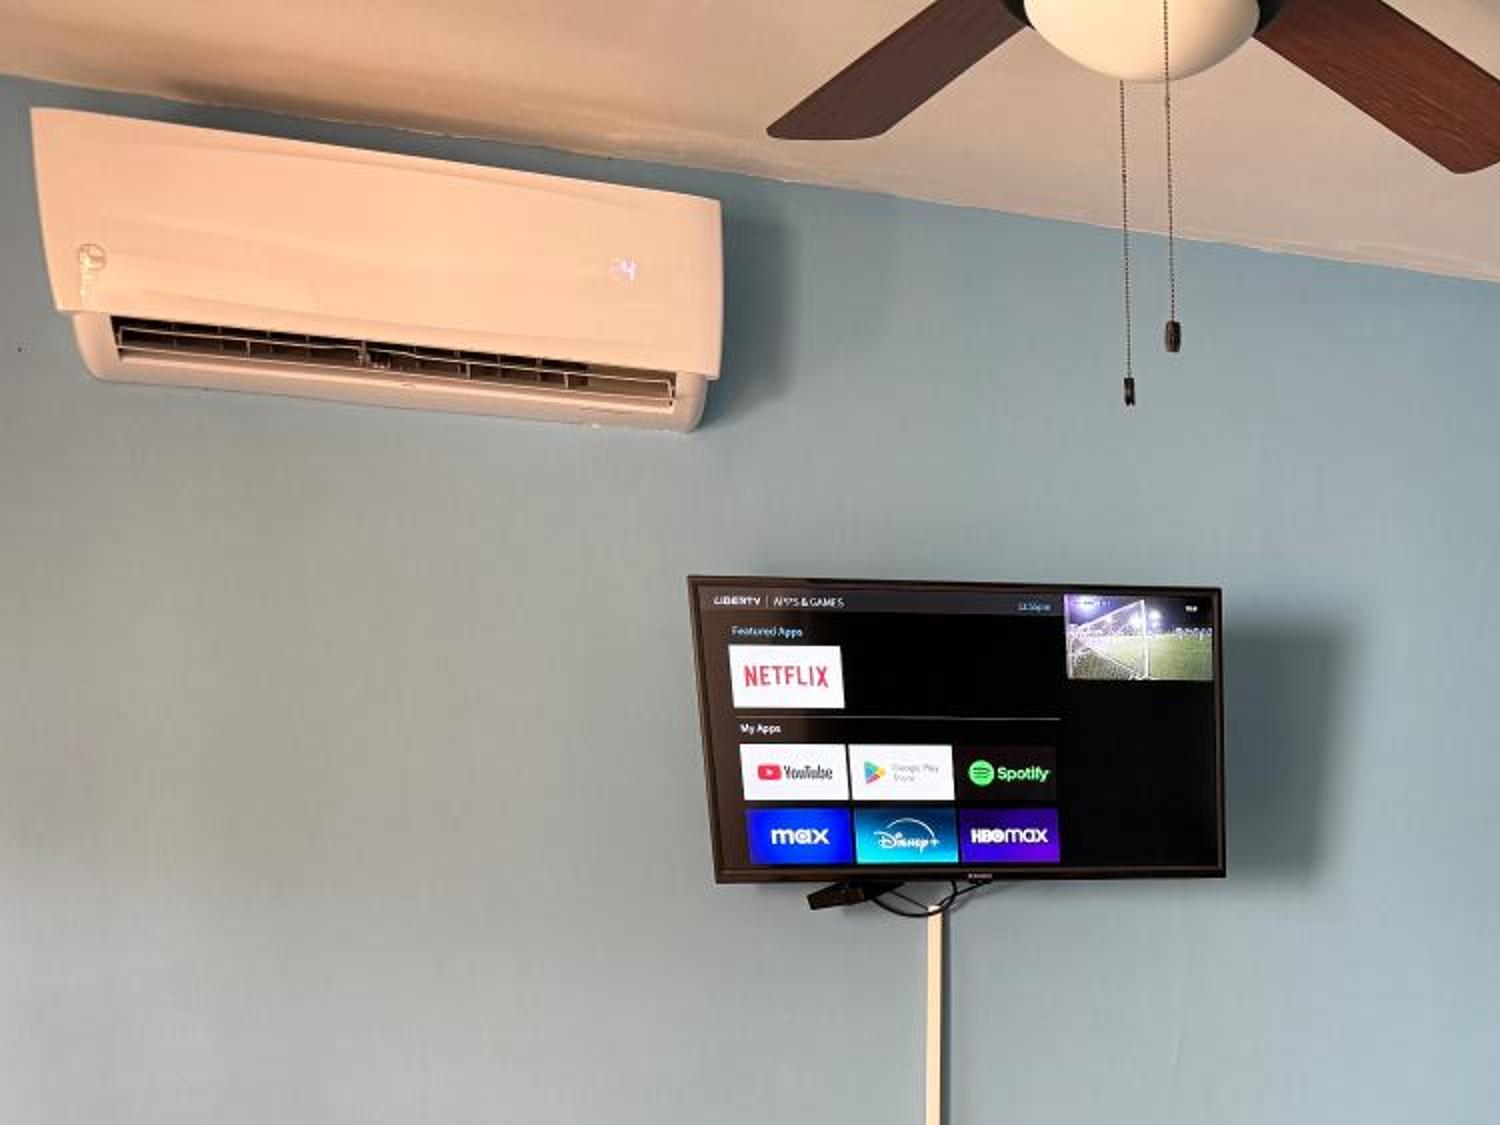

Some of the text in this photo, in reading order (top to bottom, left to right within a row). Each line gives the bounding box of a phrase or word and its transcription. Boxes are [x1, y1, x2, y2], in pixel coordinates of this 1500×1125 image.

[810, 597, 846, 608] GAMES
[731, 625, 803, 638] Featured Apps
[743, 665, 829, 688] NETFLIX
[740, 723, 782, 735] My Apps
[783, 765, 833, 780] YouTube
[924, 763, 940, 774] Play
[997, 766, 1050, 782] Spotify
[770, 828, 830, 845] max
